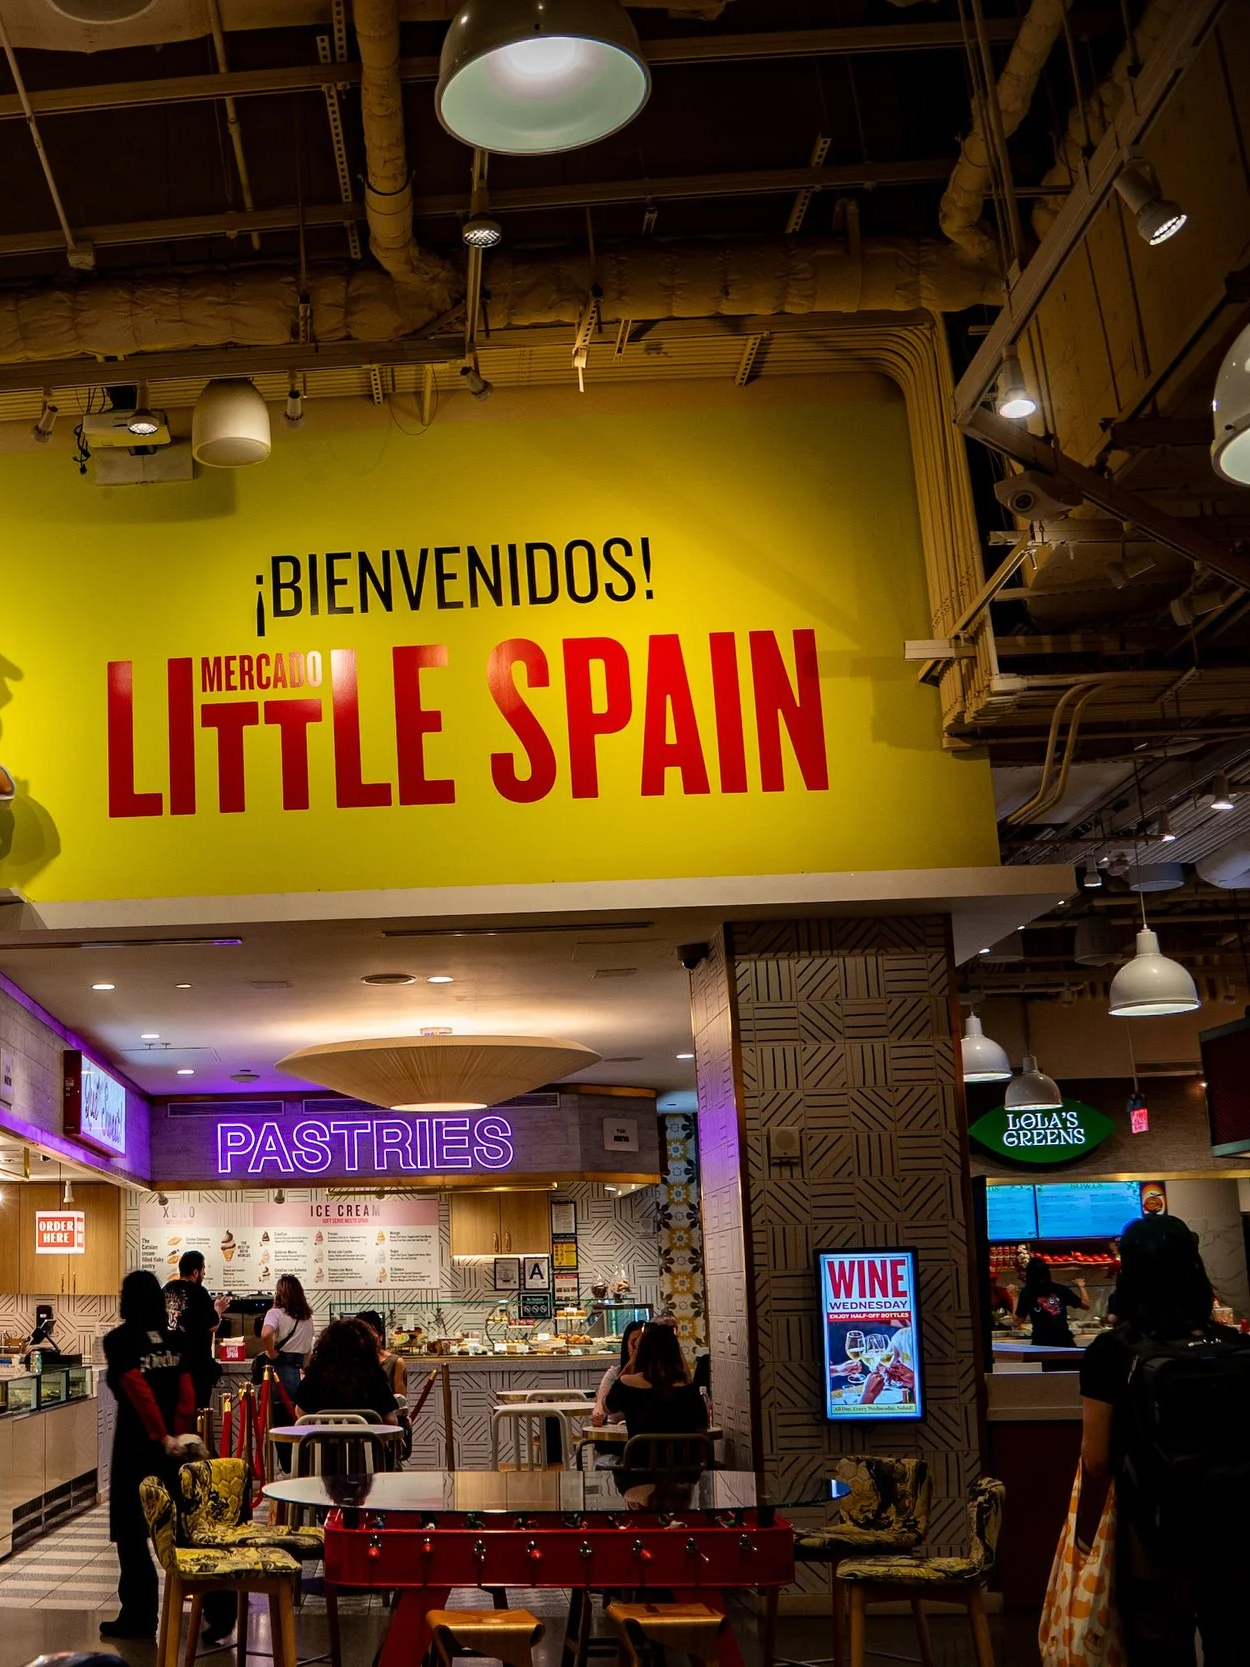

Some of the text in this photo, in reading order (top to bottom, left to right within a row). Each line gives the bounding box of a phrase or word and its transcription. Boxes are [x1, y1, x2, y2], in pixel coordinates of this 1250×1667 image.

[255, 536, 654, 636] ¡BIENVENIDOS!
[201, 650, 322, 692] MERCADO
[107, 629, 829, 818] LITTLE SPAIN
[1007, 1112, 1078, 1130] LOLA'S
[218, 1116, 514, 1173] PASTRIES
[1003, 1129, 1086, 1146] GREENS
[310, 1204, 380, 1217] ICE CREAM
[39, 1220, 74, 1231] ORDER
[43, 1232, 70, 1243] HERE
[529, 1263, 544, 1279] A
[827, 1259, 907, 1299] WINE
[829, 1300, 907, 1310] WEDNESDAY
